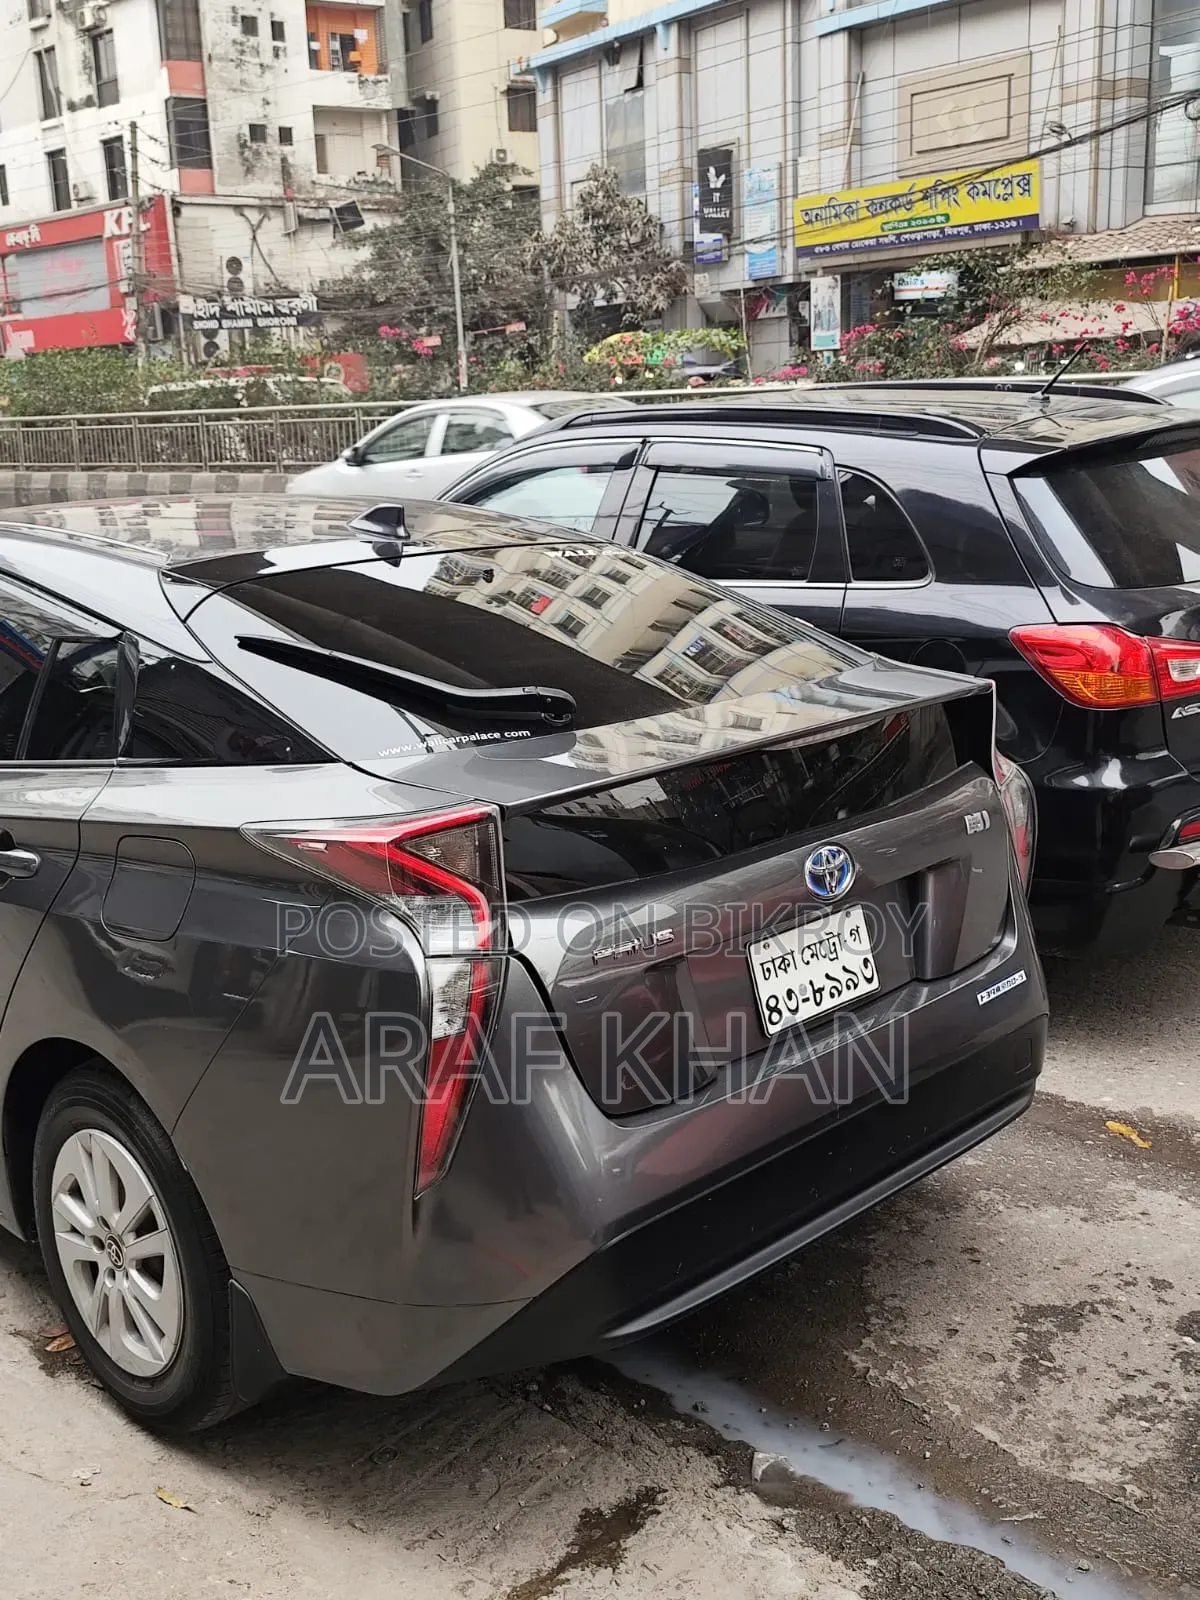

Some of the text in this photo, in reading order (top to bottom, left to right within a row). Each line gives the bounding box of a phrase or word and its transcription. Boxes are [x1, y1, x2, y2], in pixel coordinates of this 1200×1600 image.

[800, 197, 859, 225] অনামিকা
[759, 949, 798, 981] ঢাকা
[765, 957, 875, 1026] ৪৩-৮৯৯৩
